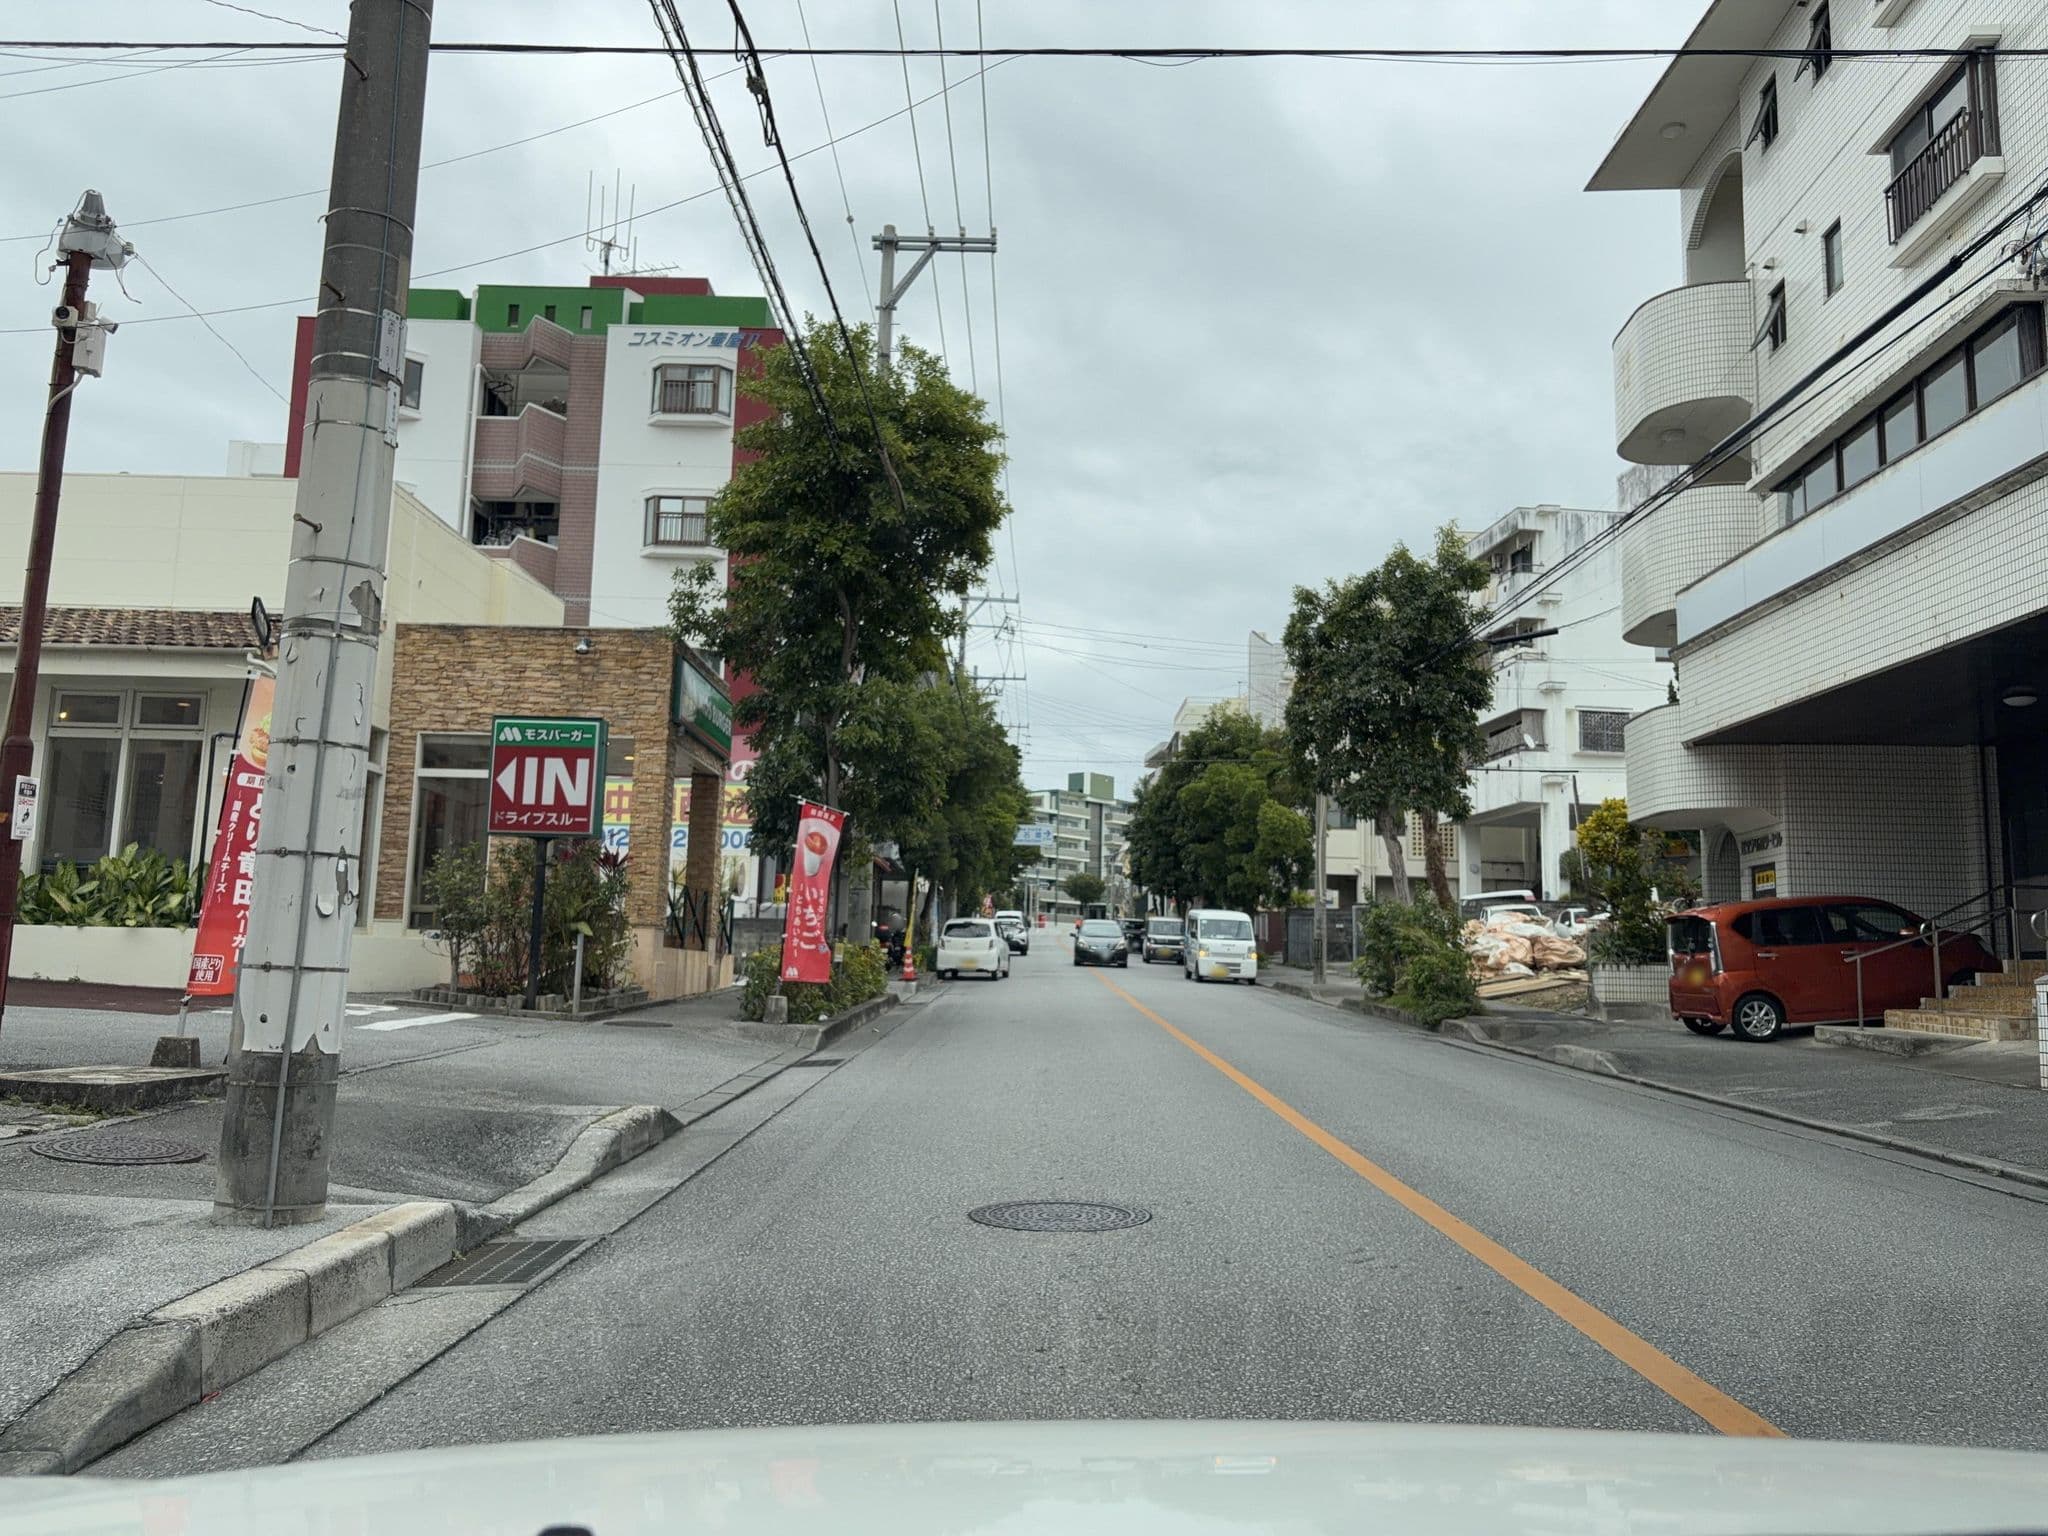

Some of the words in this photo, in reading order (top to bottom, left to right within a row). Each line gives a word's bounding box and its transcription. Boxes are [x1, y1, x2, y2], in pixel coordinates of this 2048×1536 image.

[525, 729, 593, 742] モスバーガー
[522, 757, 590, 806] IN
[494, 811, 588, 826] ドライブスルー
[800, 886, 821, 950] いちご
[193, 956, 221, 970] 国産どり
[195, 970, 214, 982] 使用
